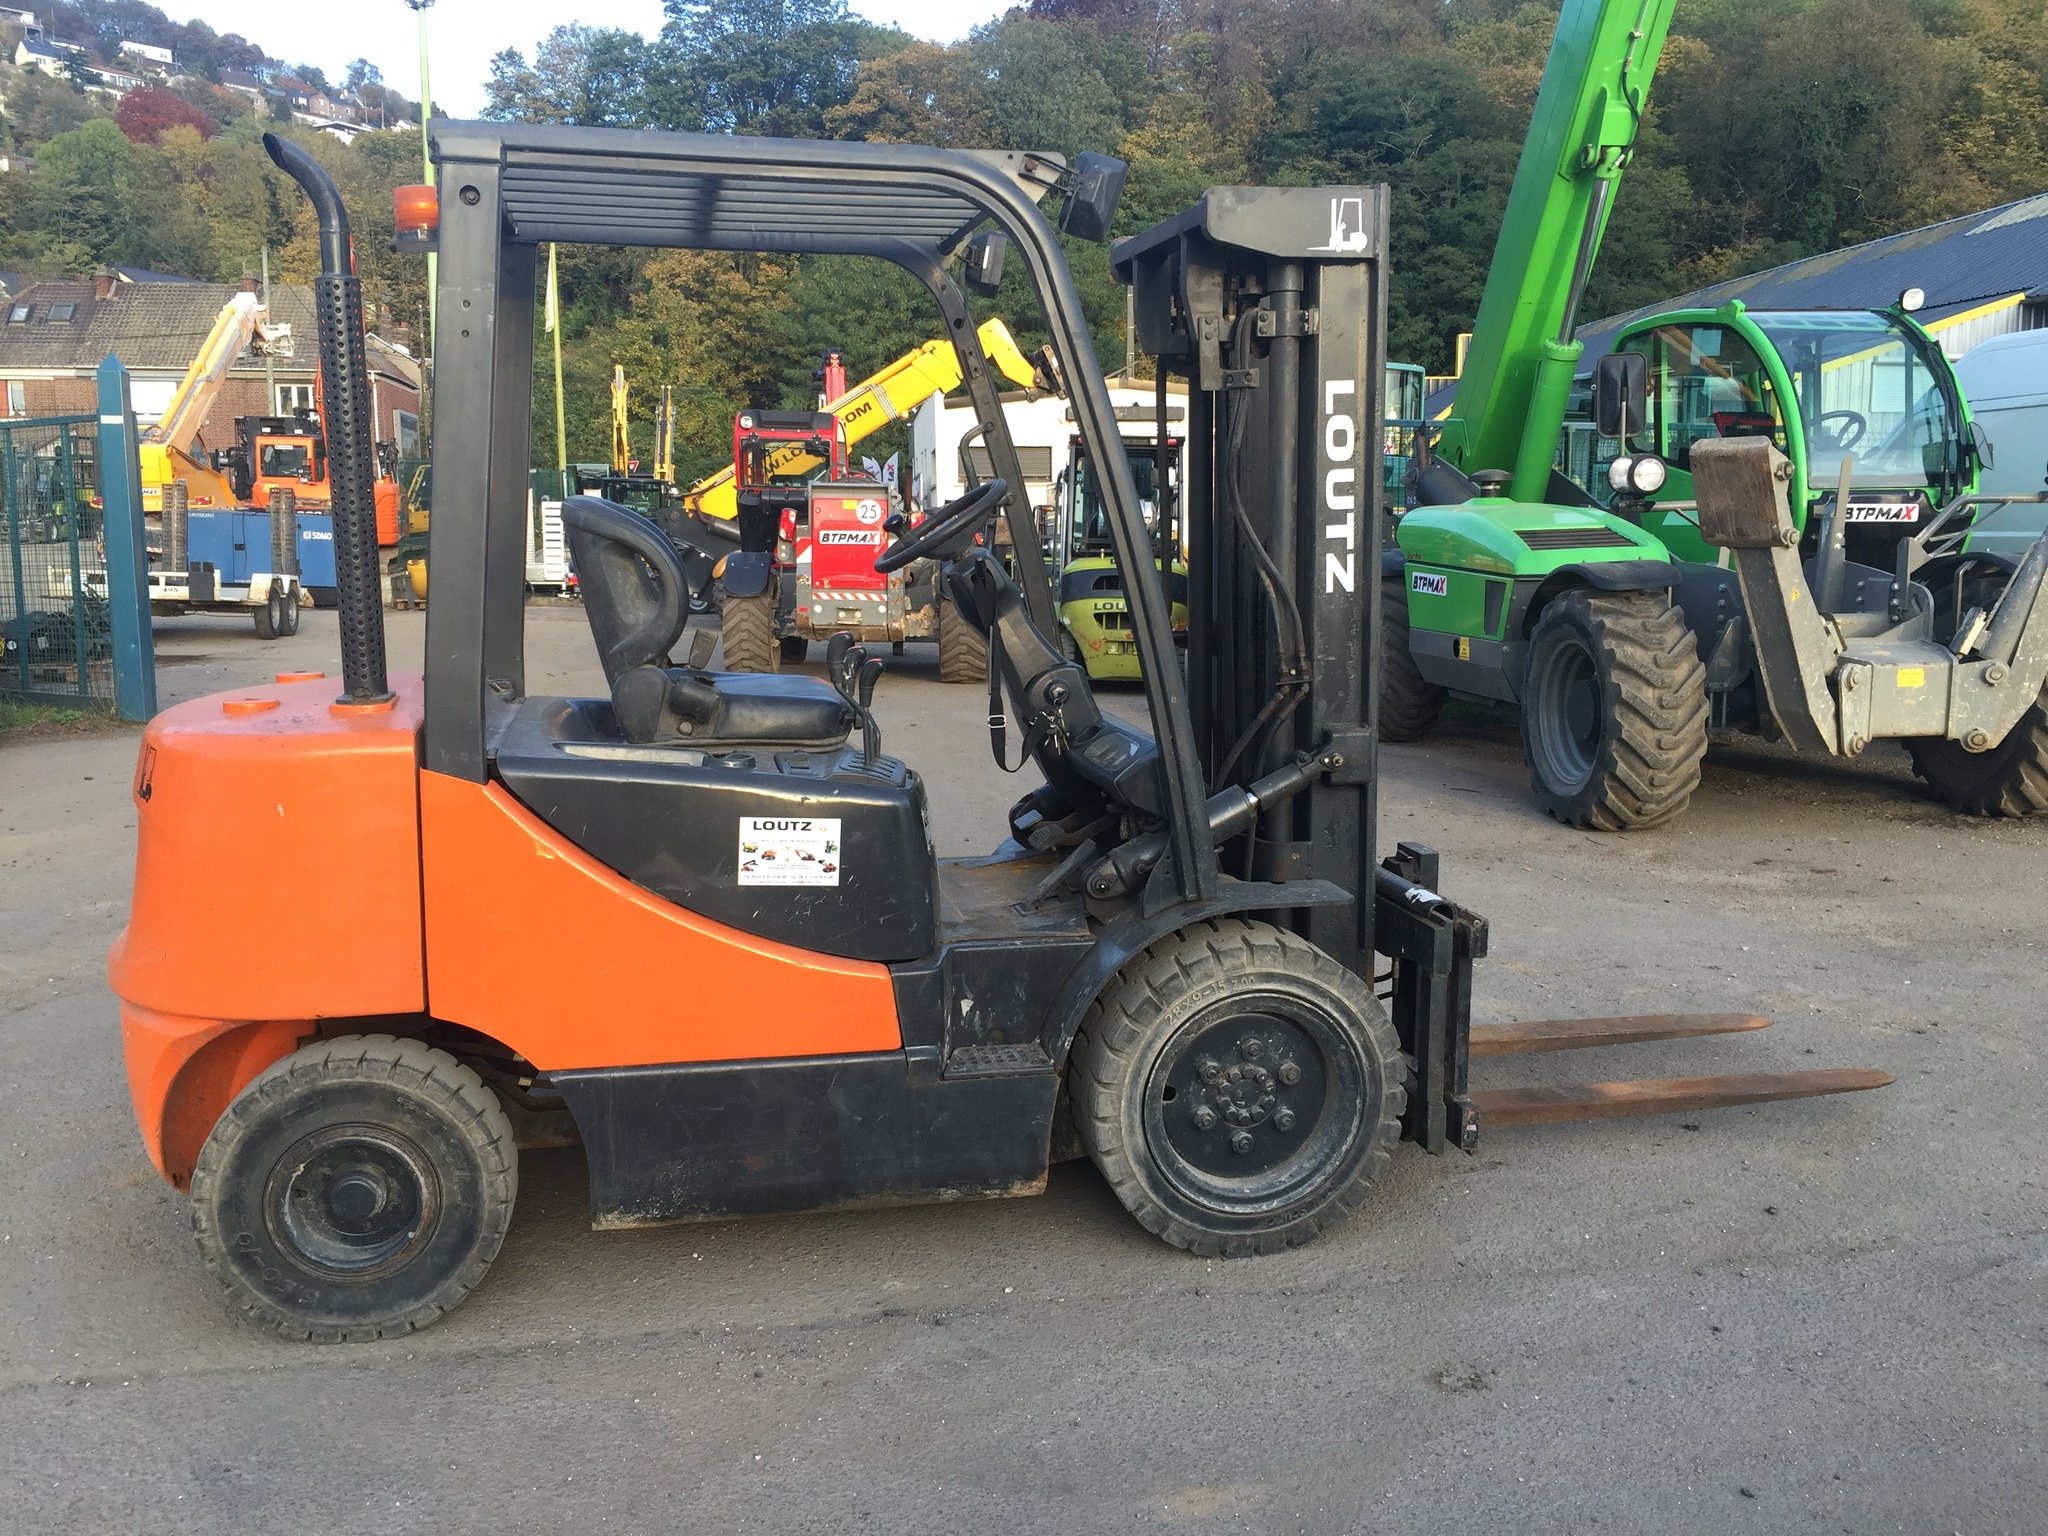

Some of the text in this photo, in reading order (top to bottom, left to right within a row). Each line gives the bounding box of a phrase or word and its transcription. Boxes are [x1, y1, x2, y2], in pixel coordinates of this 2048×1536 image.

[1325, 379, 1355, 594] LOUTZ
[860, 504, 877, 519] 25
[1844, 505, 1917, 520] BTPMAX
[312, 531, 332, 540] SDMO
[821, 532, 878, 543] BTPMAX
[1412, 574, 1446, 594] BTPMAX
[1093, 602, 1125, 611] LOU
[753, 820, 812, 831] LOUTZ
